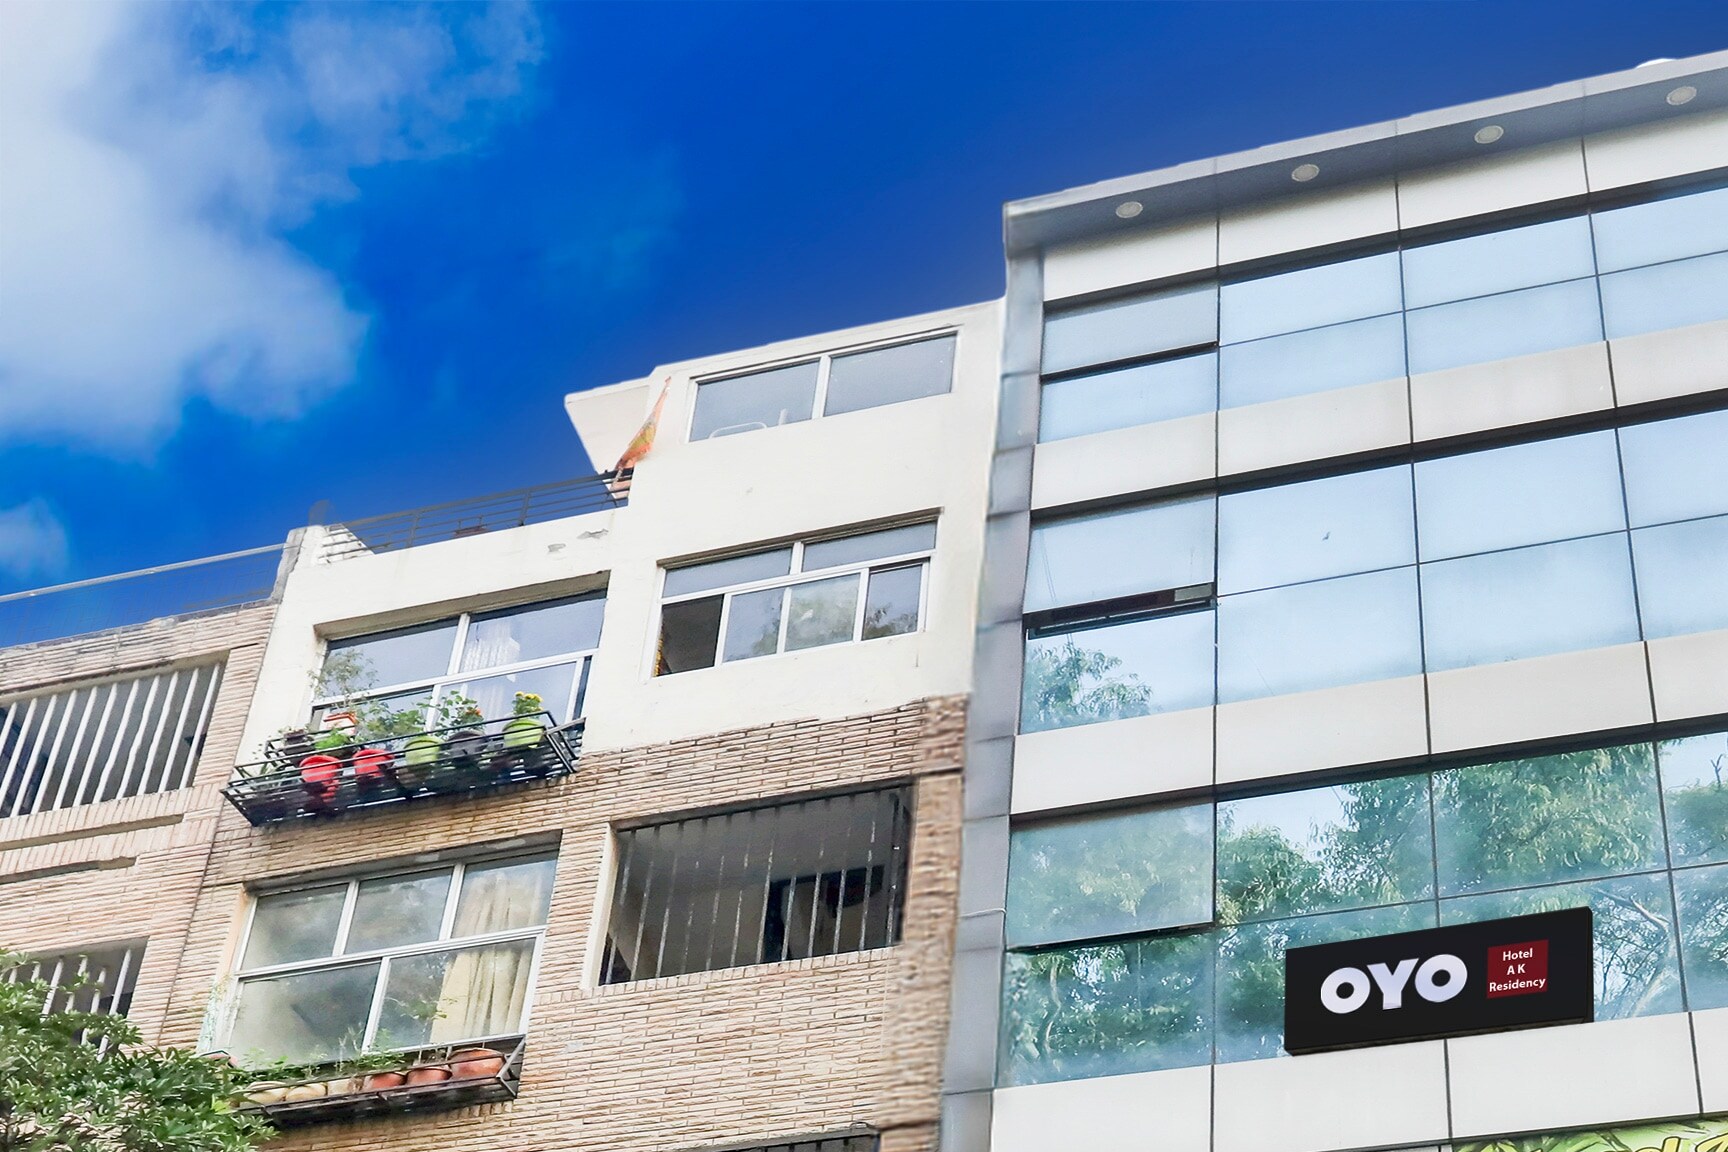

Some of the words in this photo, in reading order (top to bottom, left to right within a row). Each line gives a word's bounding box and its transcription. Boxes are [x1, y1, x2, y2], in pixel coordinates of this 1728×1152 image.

[1502, 948, 1533, 962] Hotel
[1507, 964, 1515, 975] A
[1518, 963, 1526, 974] K
[1320, 954, 1468, 1014] OYO
[1489, 977, 1546, 993] Residency
